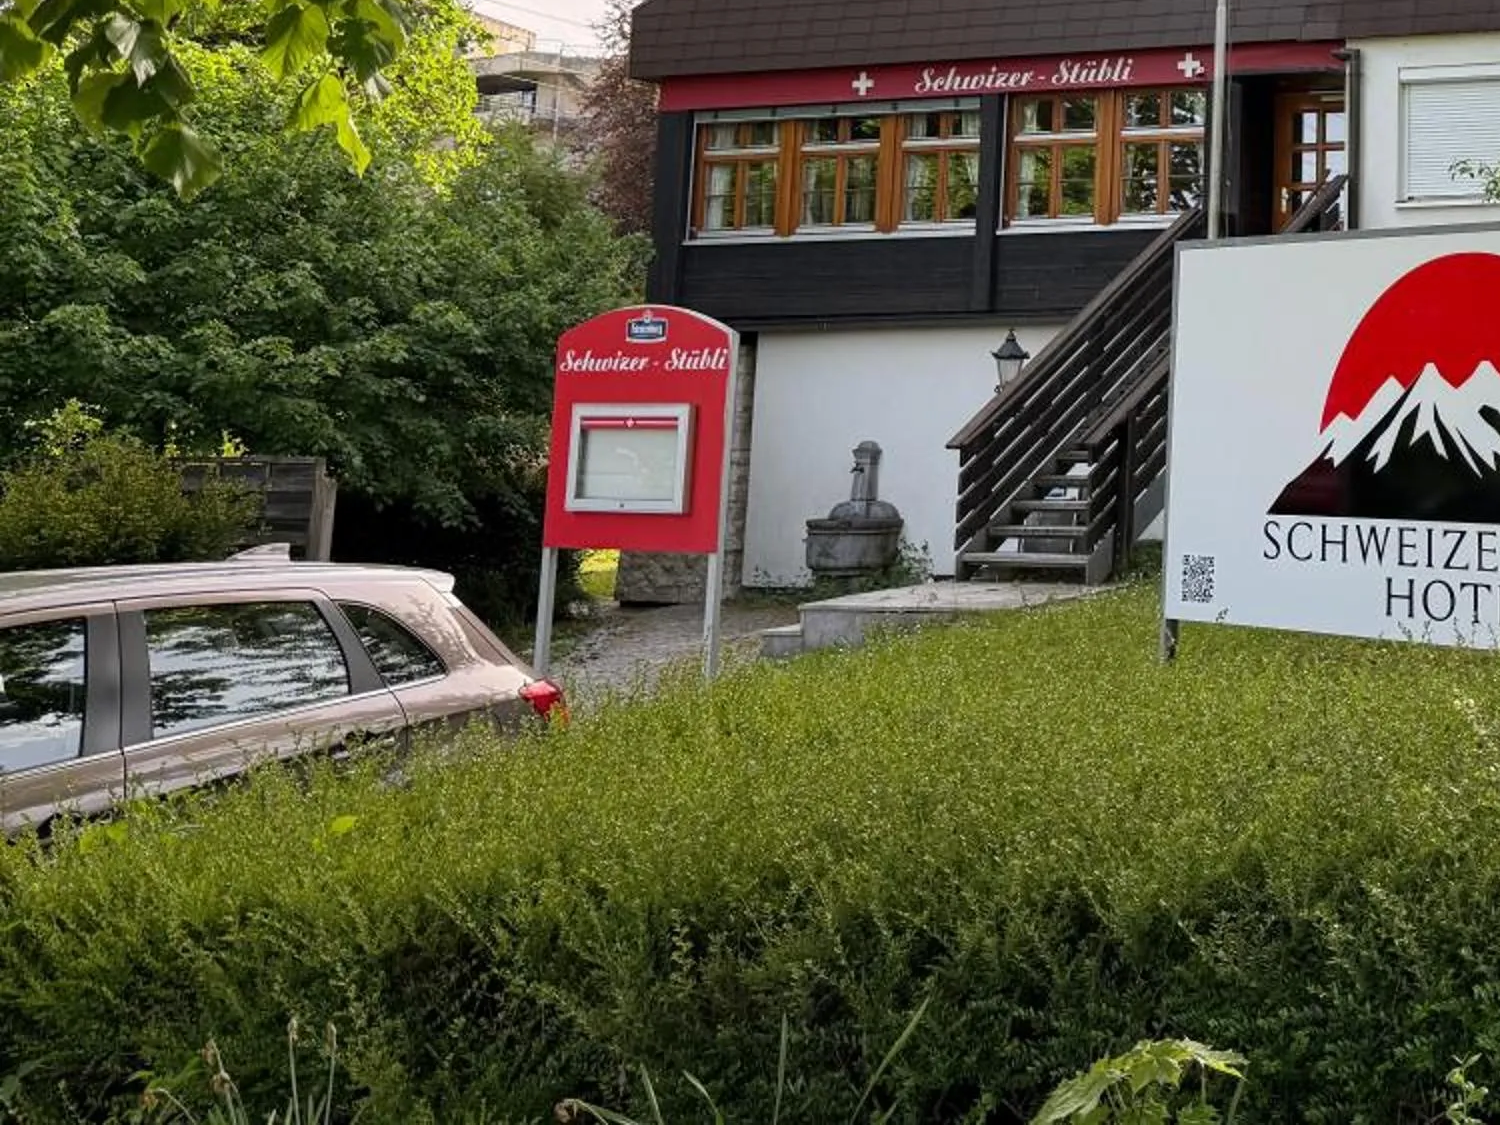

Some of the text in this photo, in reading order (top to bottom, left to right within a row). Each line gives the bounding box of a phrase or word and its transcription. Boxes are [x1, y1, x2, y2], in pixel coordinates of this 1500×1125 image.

[914, 64, 1034, 93] Schwizer
[1051, 57, 1134, 85] Stübli
[559, 349, 648, 372] Schwizer
[664, 347, 729, 371] Stübli
